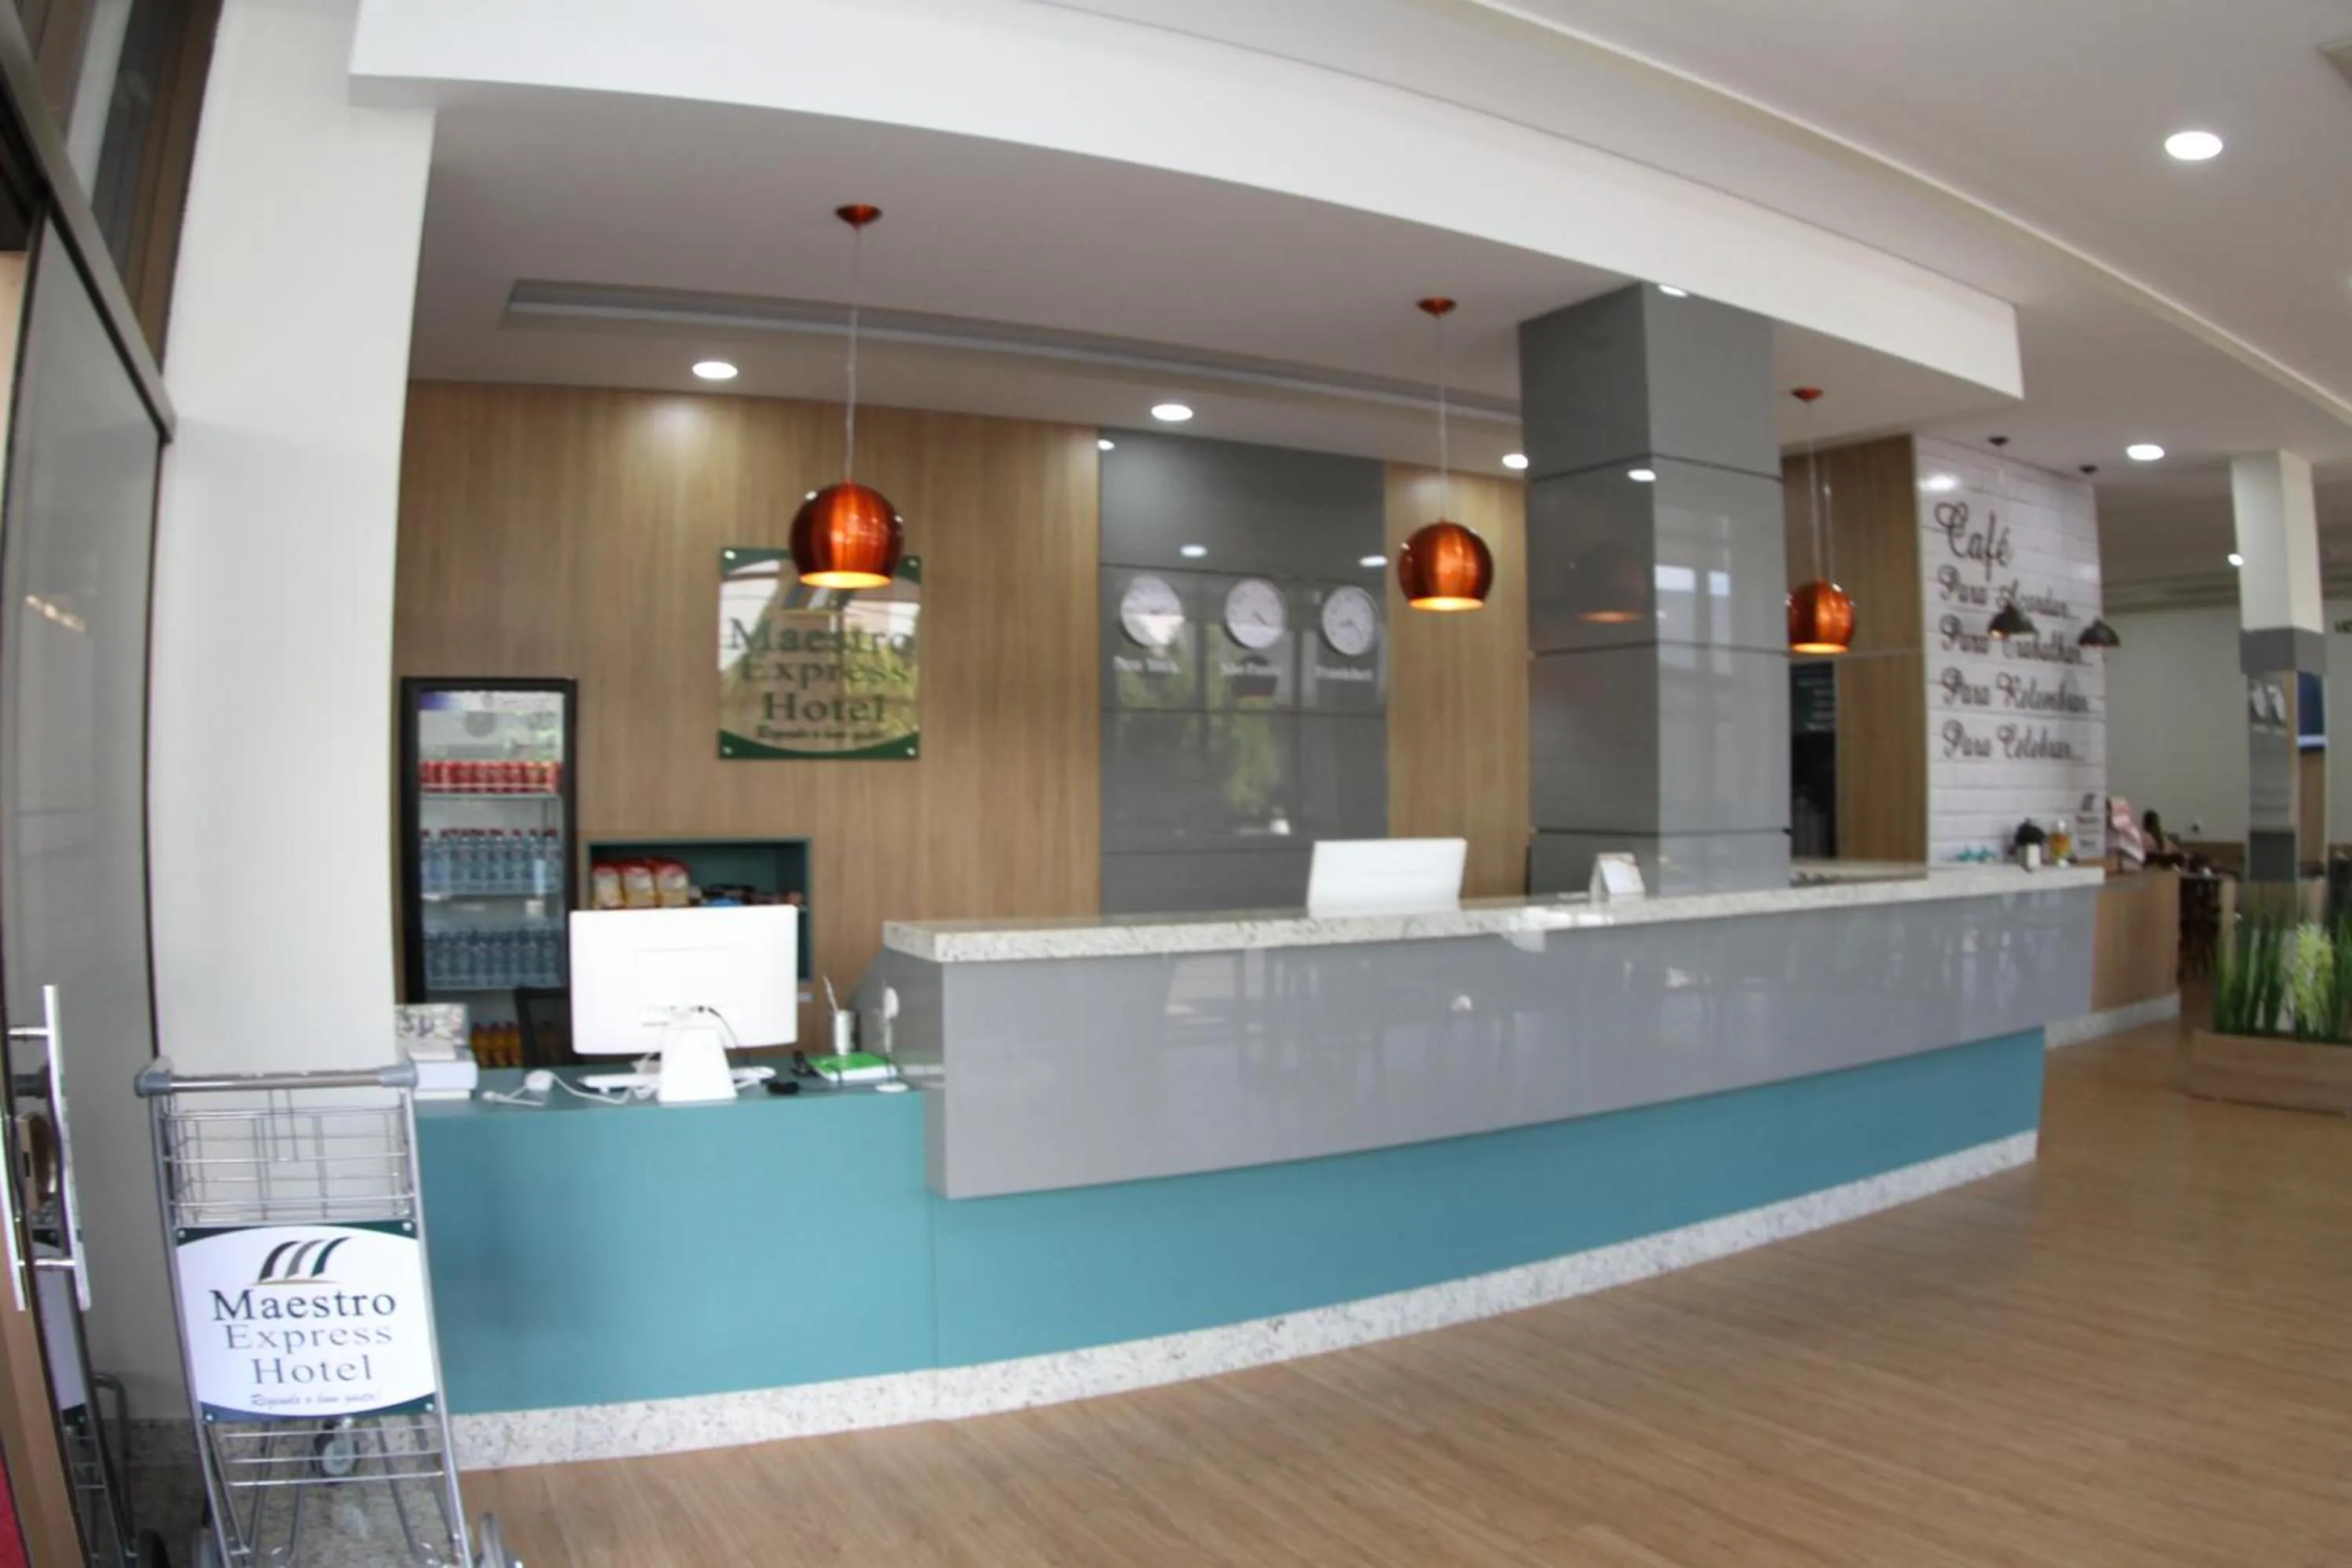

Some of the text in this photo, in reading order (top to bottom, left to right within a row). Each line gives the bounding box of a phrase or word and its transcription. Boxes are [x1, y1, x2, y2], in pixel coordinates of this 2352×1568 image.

[1934, 502, 2012, 582] Café
[729, 617, 913, 656] Maestro
[739, 652, 910, 689] Express
[763, 691, 885, 722] Hotel
[209, 1288, 397, 1322] Maestro
[224, 1323, 393, 1355] Express
[252, 1354, 374, 1385] Hotel
